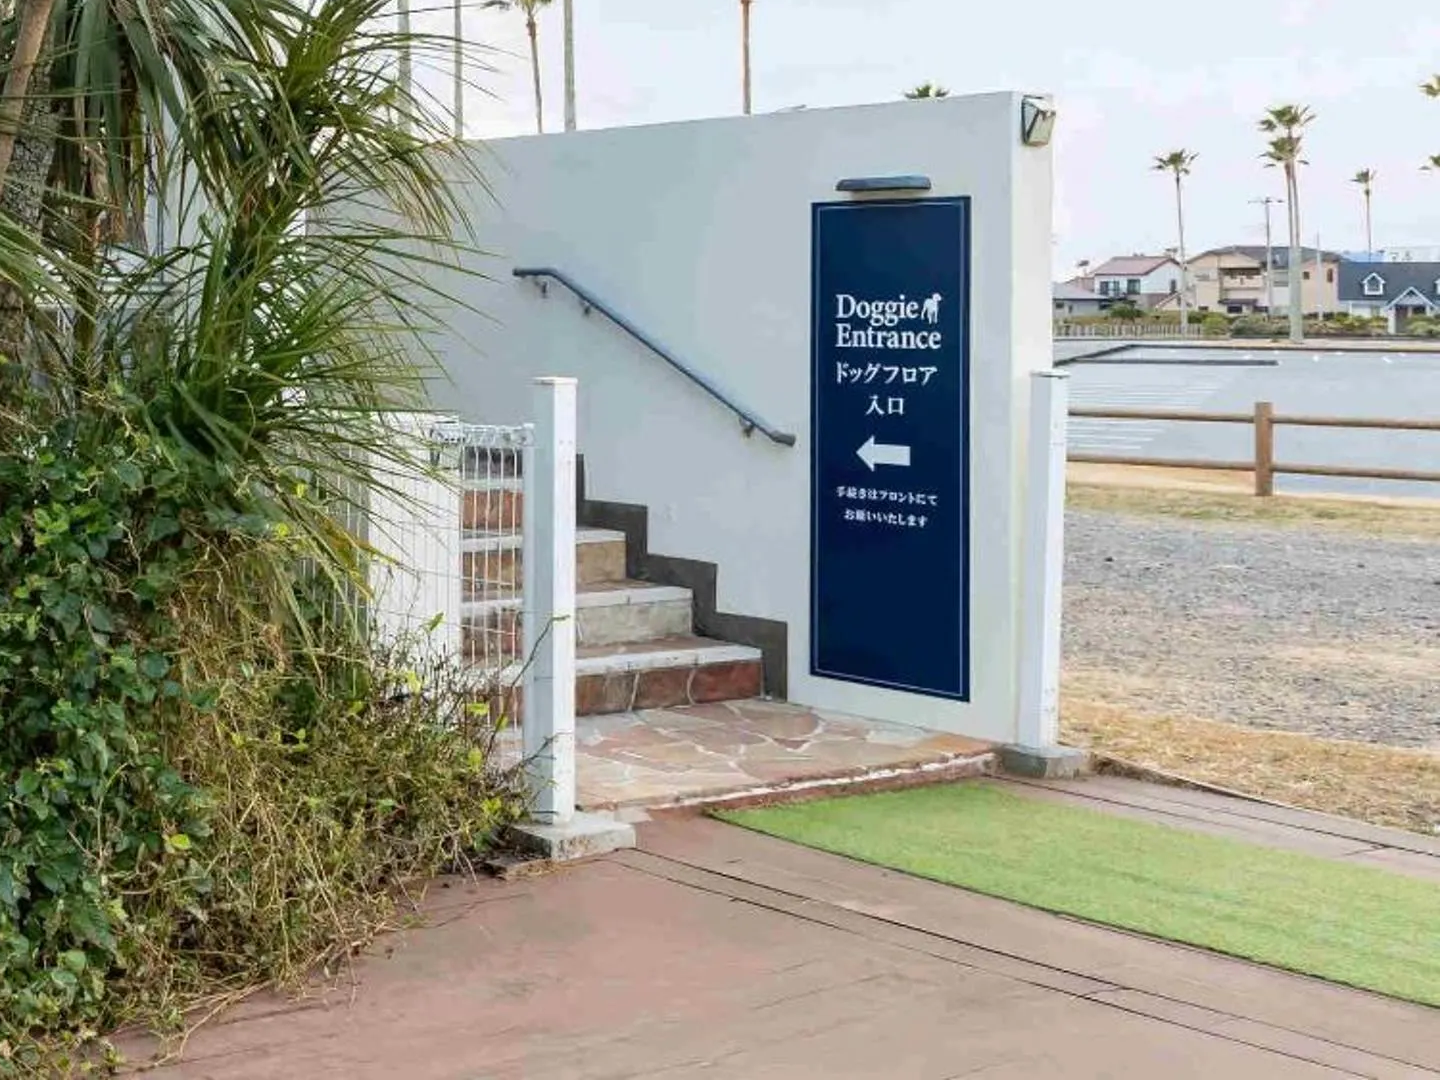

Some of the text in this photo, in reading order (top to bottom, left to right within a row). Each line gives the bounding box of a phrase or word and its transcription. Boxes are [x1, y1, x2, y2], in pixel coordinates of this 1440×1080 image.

[836, 293, 919, 326] Doggie
[835, 323, 941, 349] Entrance
[836, 361, 938, 385] ドッグフロア
[866, 395, 905, 416] 入口
